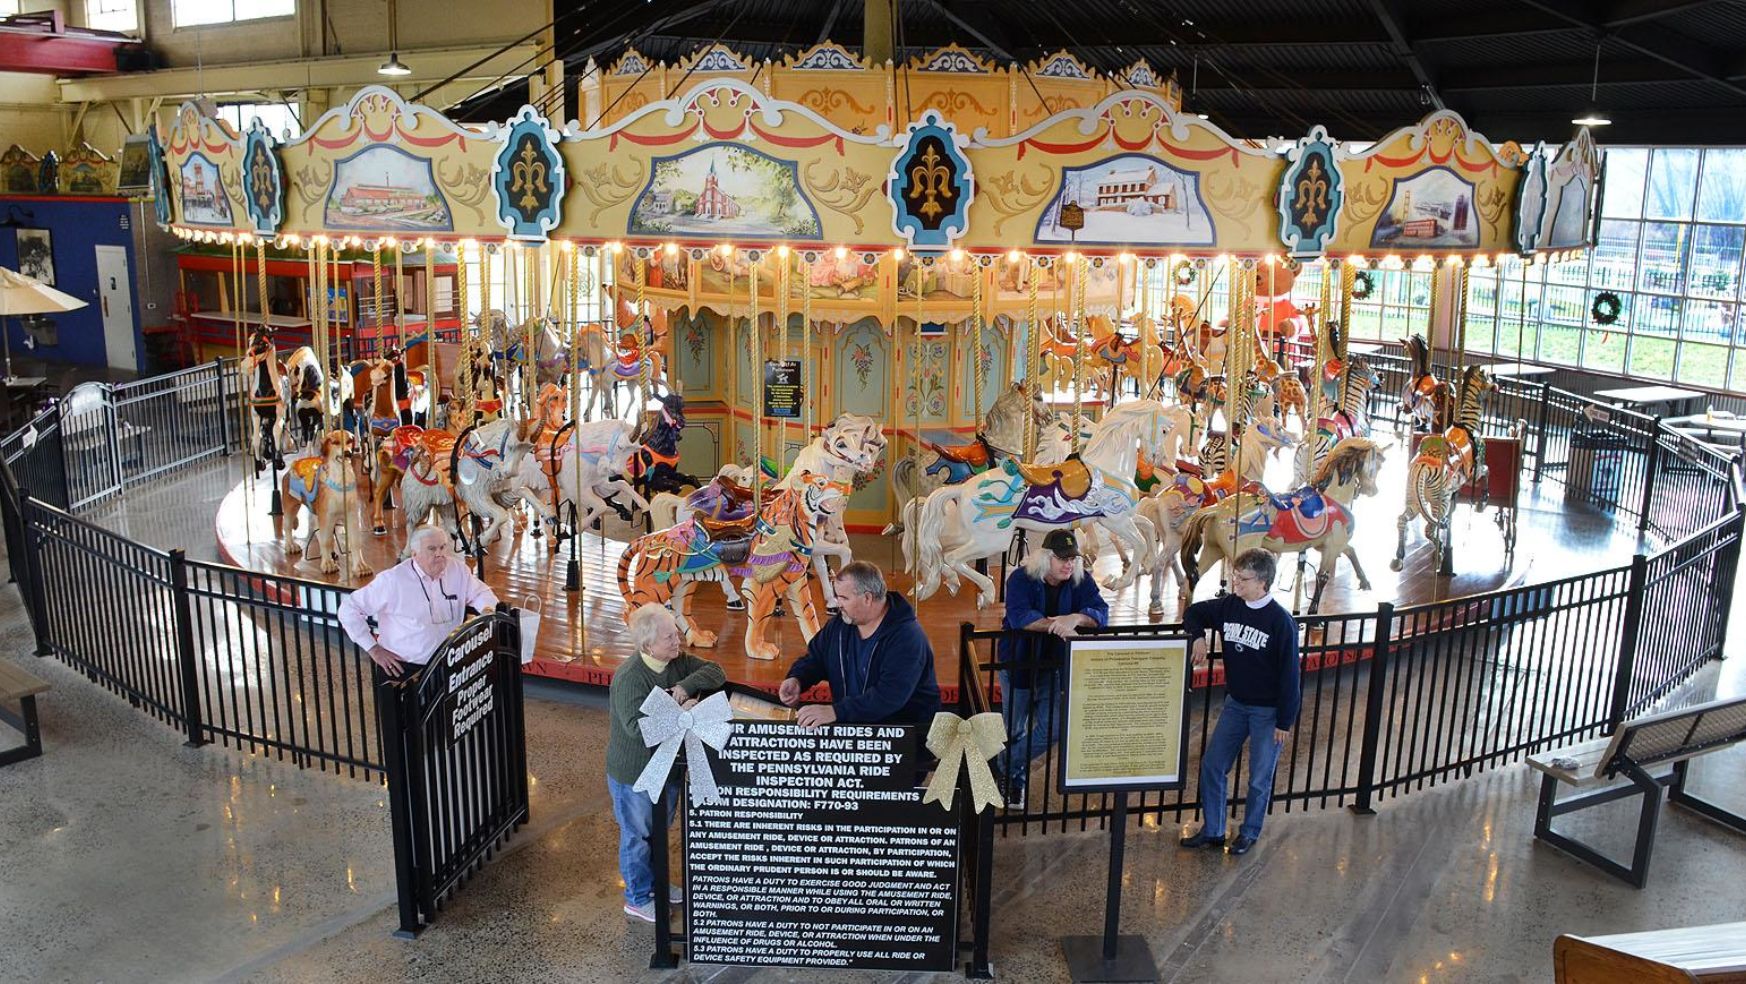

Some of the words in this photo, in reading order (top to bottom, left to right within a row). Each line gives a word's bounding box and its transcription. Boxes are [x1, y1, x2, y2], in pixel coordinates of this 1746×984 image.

[1223, 622, 1244, 642] PENN
[1243, 626, 1270, 648] STATE
[447, 621, 493, 668] Carousel
[448, 649, 494, 694] Entrance
[457, 674, 486, 706] Proper
[452, 684, 493, 726] Footwear
[454, 695, 494, 740] Required
[748, 724, 830, 736] AMUSEMENT
[834, 726, 873, 736] RIDES
[877, 727, 905, 738] AND
[730, 737, 816, 748] ATTRACTIONS
[820, 740, 853, 749] HAVE
[857, 740, 891, 750] BEEN
[718, 750, 790, 760] INSPECTED
[794, 751, 811, 761] AS
[815, 752, 881, 763] REQUIRED
[885, 754, 902, 763] BY
[730, 763, 754, 772] THE
[758, 764, 856, 775] PENNSYLVANIA
[860, 766, 890, 776] RIDE
[756, 776, 833, 787] INSPECTION
[837, 778, 864, 788] ACT.
[736, 788, 828, 798] RESPONSIBILITY
[832, 790, 920, 800] REQUIREMENTS
[733, 798, 811, 808] DESIGNATION:
[814, 801, 858, 810] F770-93
[753, 822, 794, 830] INHERENT
[854, 826, 916, 834] PARTICIPATION
[709, 832, 761, 840] AMUSEMENT
[818, 847, 871, 855] ATTRACTION,
[888, 848, 951, 858] PARTICIPATION,
[708, 864, 751, 872] ORDINARY
[850, 858, 911, 866] PARTICIPATION
[927, 860, 955, 868] WHICH
[693, 875, 730, 883] PATRONS
[842, 880, 866, 888] GOOD
[710, 885, 767, 893] RESPONSIBLE
[878, 890, 929, 898] AMUSEMENT
[741, 895, 791, 903] ATTRACTION
[812, 897, 822, 905] TO
[835, 906, 866, 914] DURING
[693, 928, 744, 936] AMUSEMENT
[816, 932, 867, 940] ATTRACTION
[831, 924, 882, 932] PARTICIPATE
[757, 956, 805, 964] EQUIPMENT
